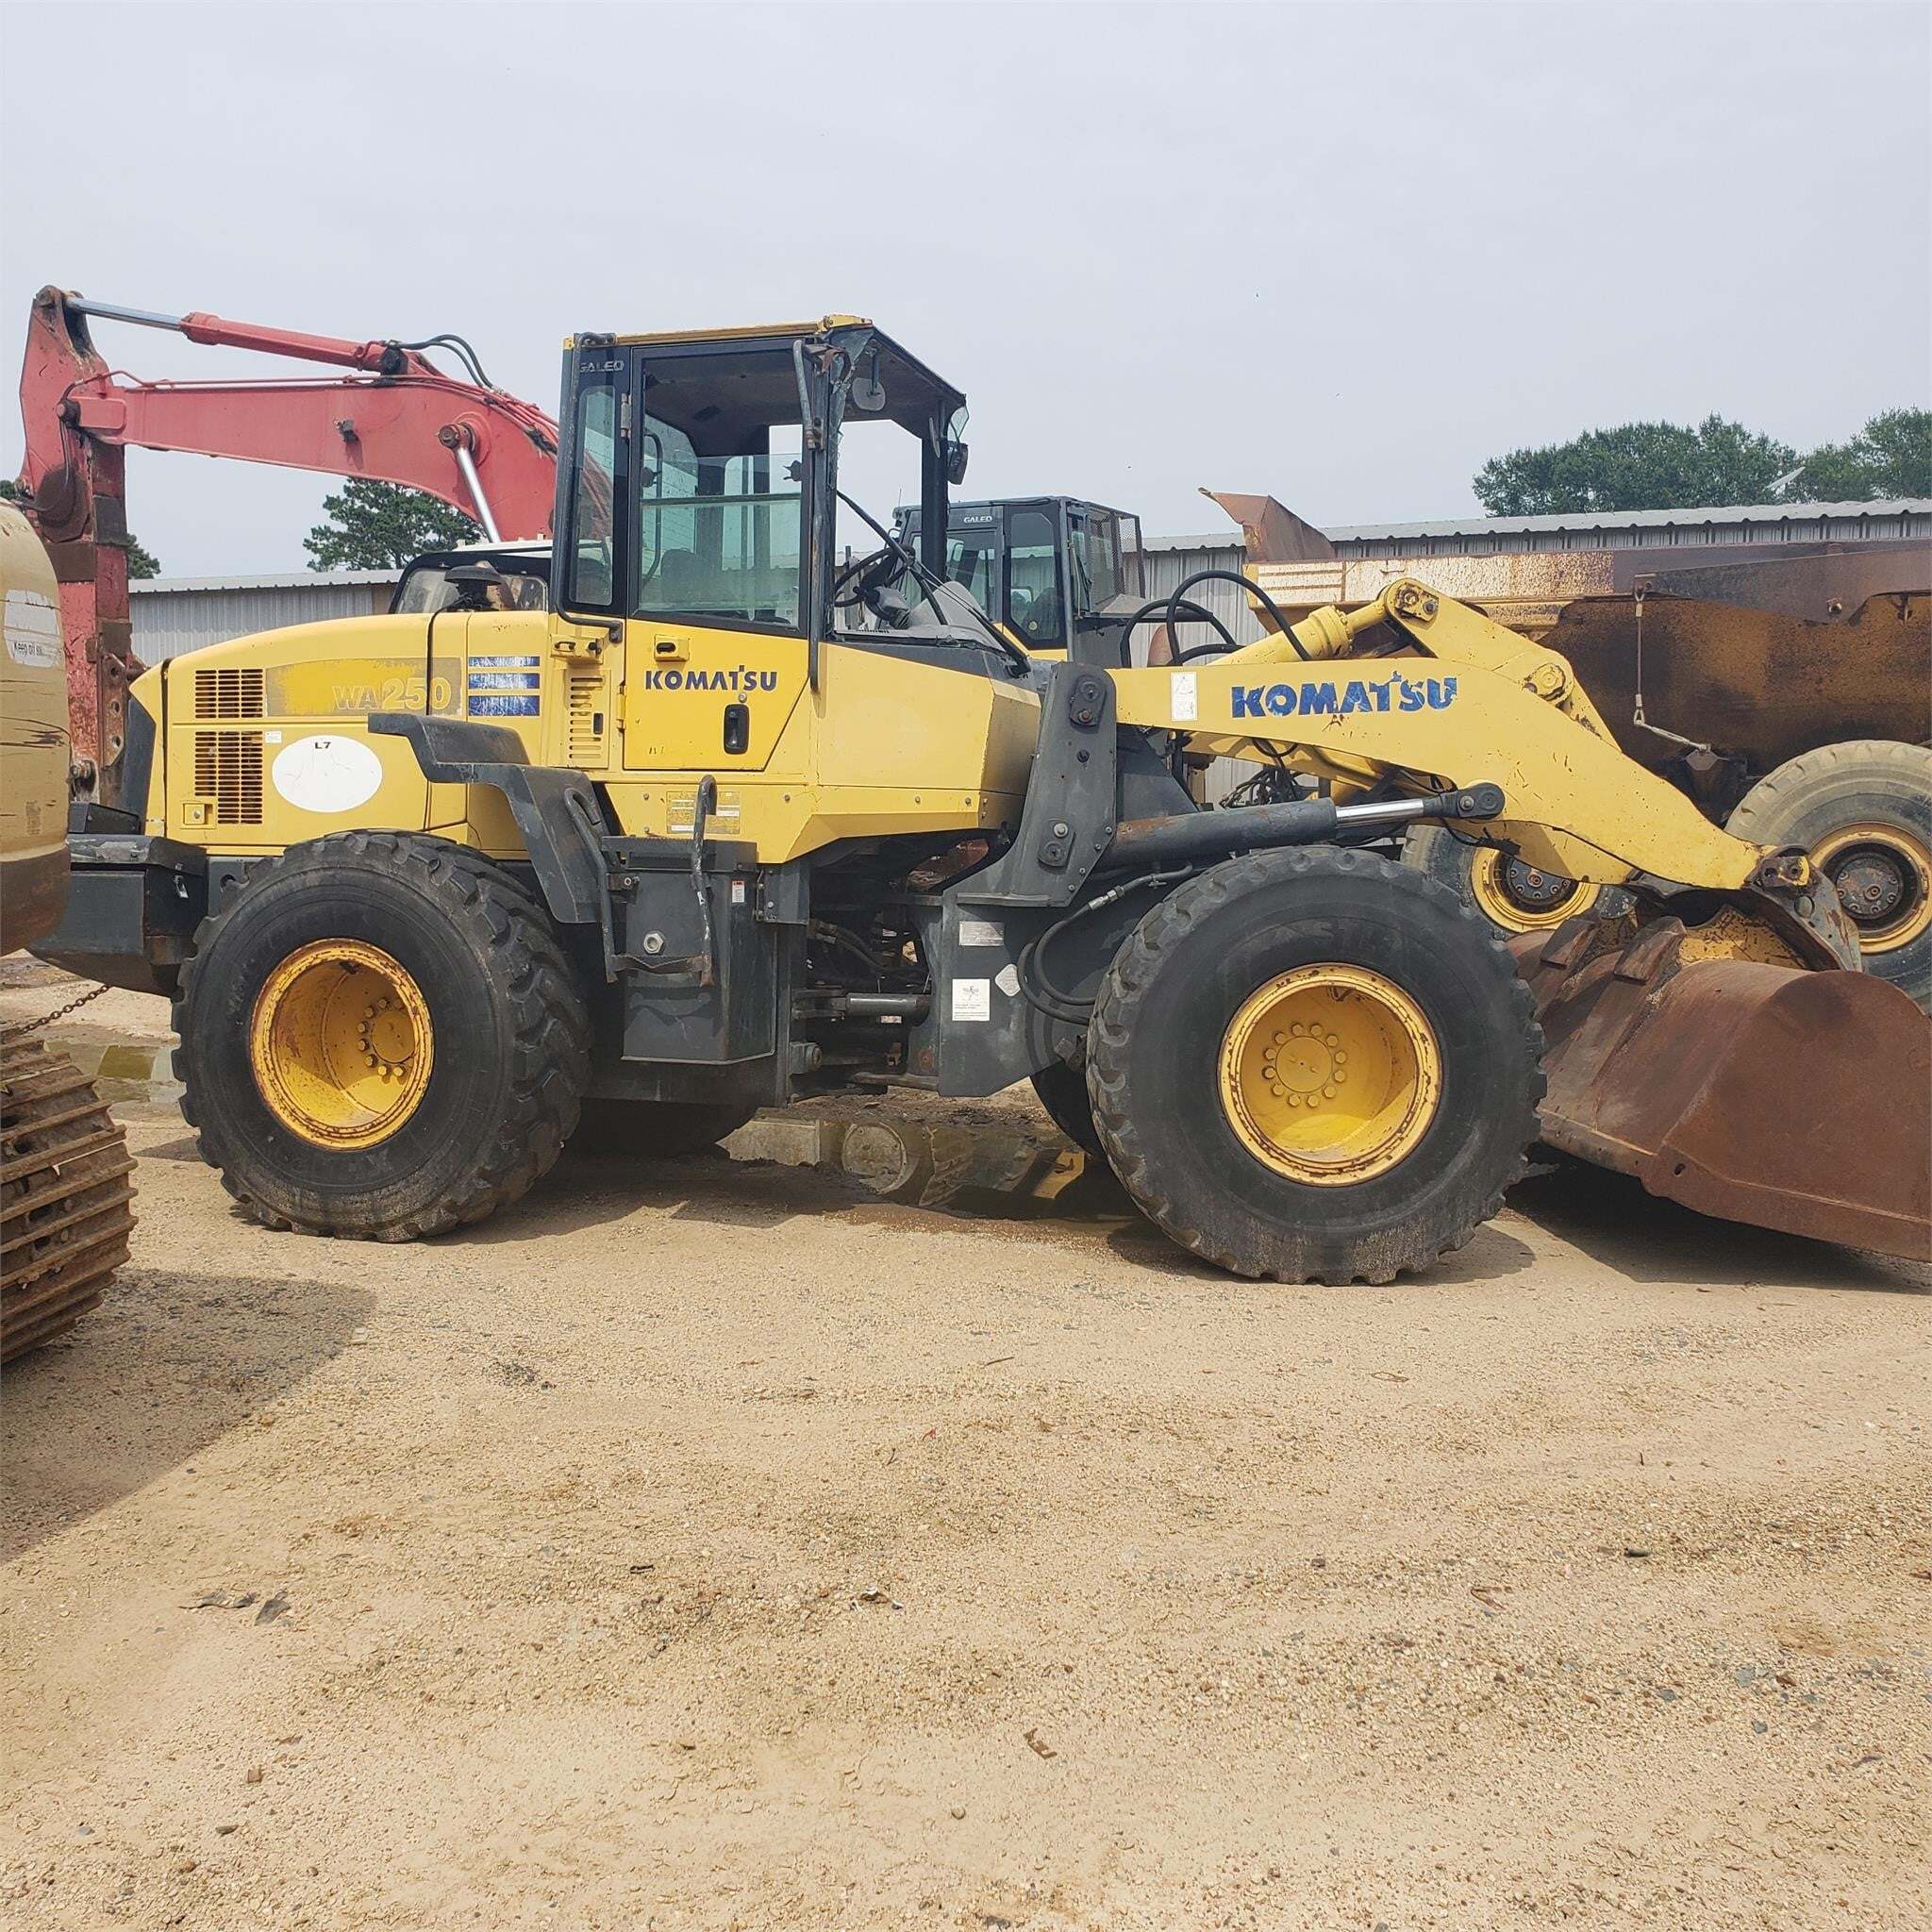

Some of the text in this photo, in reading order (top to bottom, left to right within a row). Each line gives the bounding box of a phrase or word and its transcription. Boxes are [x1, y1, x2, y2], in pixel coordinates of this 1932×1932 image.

[580, 360, 625, 373] GALEO
[963, 515, 992, 524] GALEO
[645, 665, 777, 691] KOMATSU
[331, 677, 451, 710] WA250
[1231, 671, 1457, 718] KOMATSU
[314, 741, 332, 750] L7
